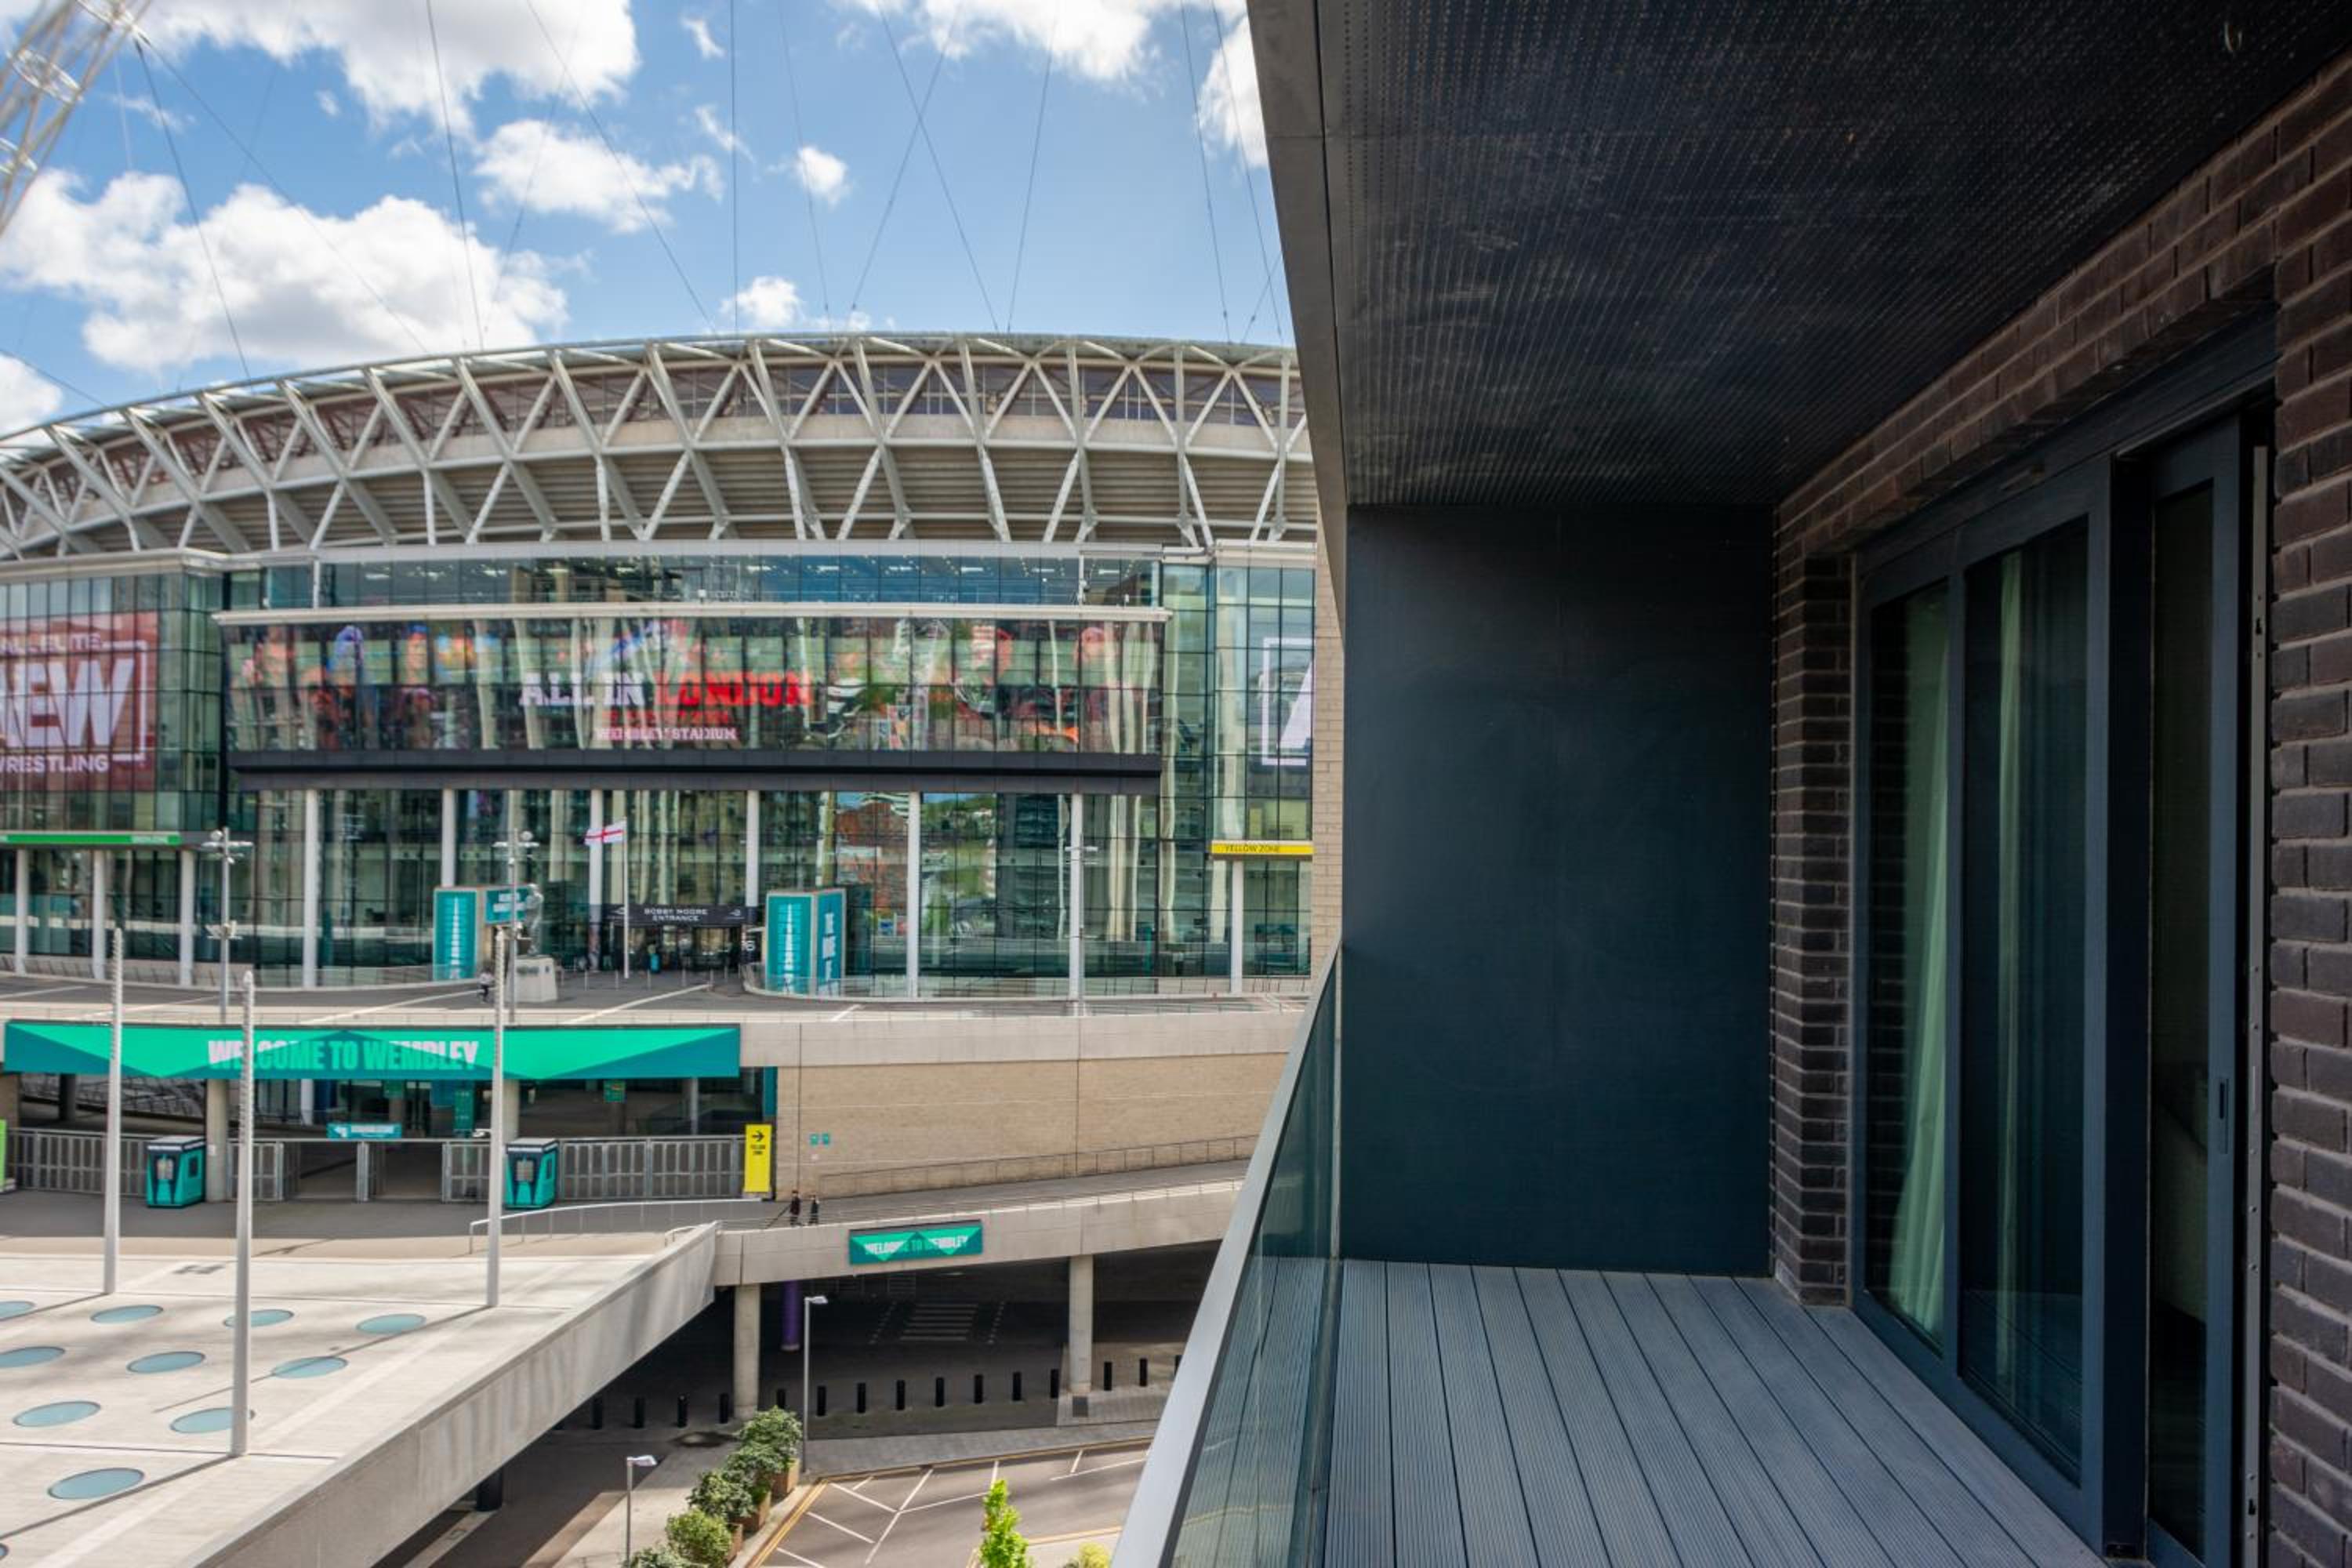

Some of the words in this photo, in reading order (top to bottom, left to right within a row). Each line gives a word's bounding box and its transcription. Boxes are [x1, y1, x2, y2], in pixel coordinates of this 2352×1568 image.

[518, 672, 596, 706] ALL
[601, 672, 646, 706] IN
[652, 670, 815, 707] LONDON
[672, 727, 737, 741] STADIUM
[1225, 843, 1258, 853] YELLOW
[1259, 843, 1279, 853] ZONE
[208, 1040, 325, 1070] WECOME
[328, 1040, 358, 1070] TO
[362, 1040, 480, 1070] WEMBLEY
